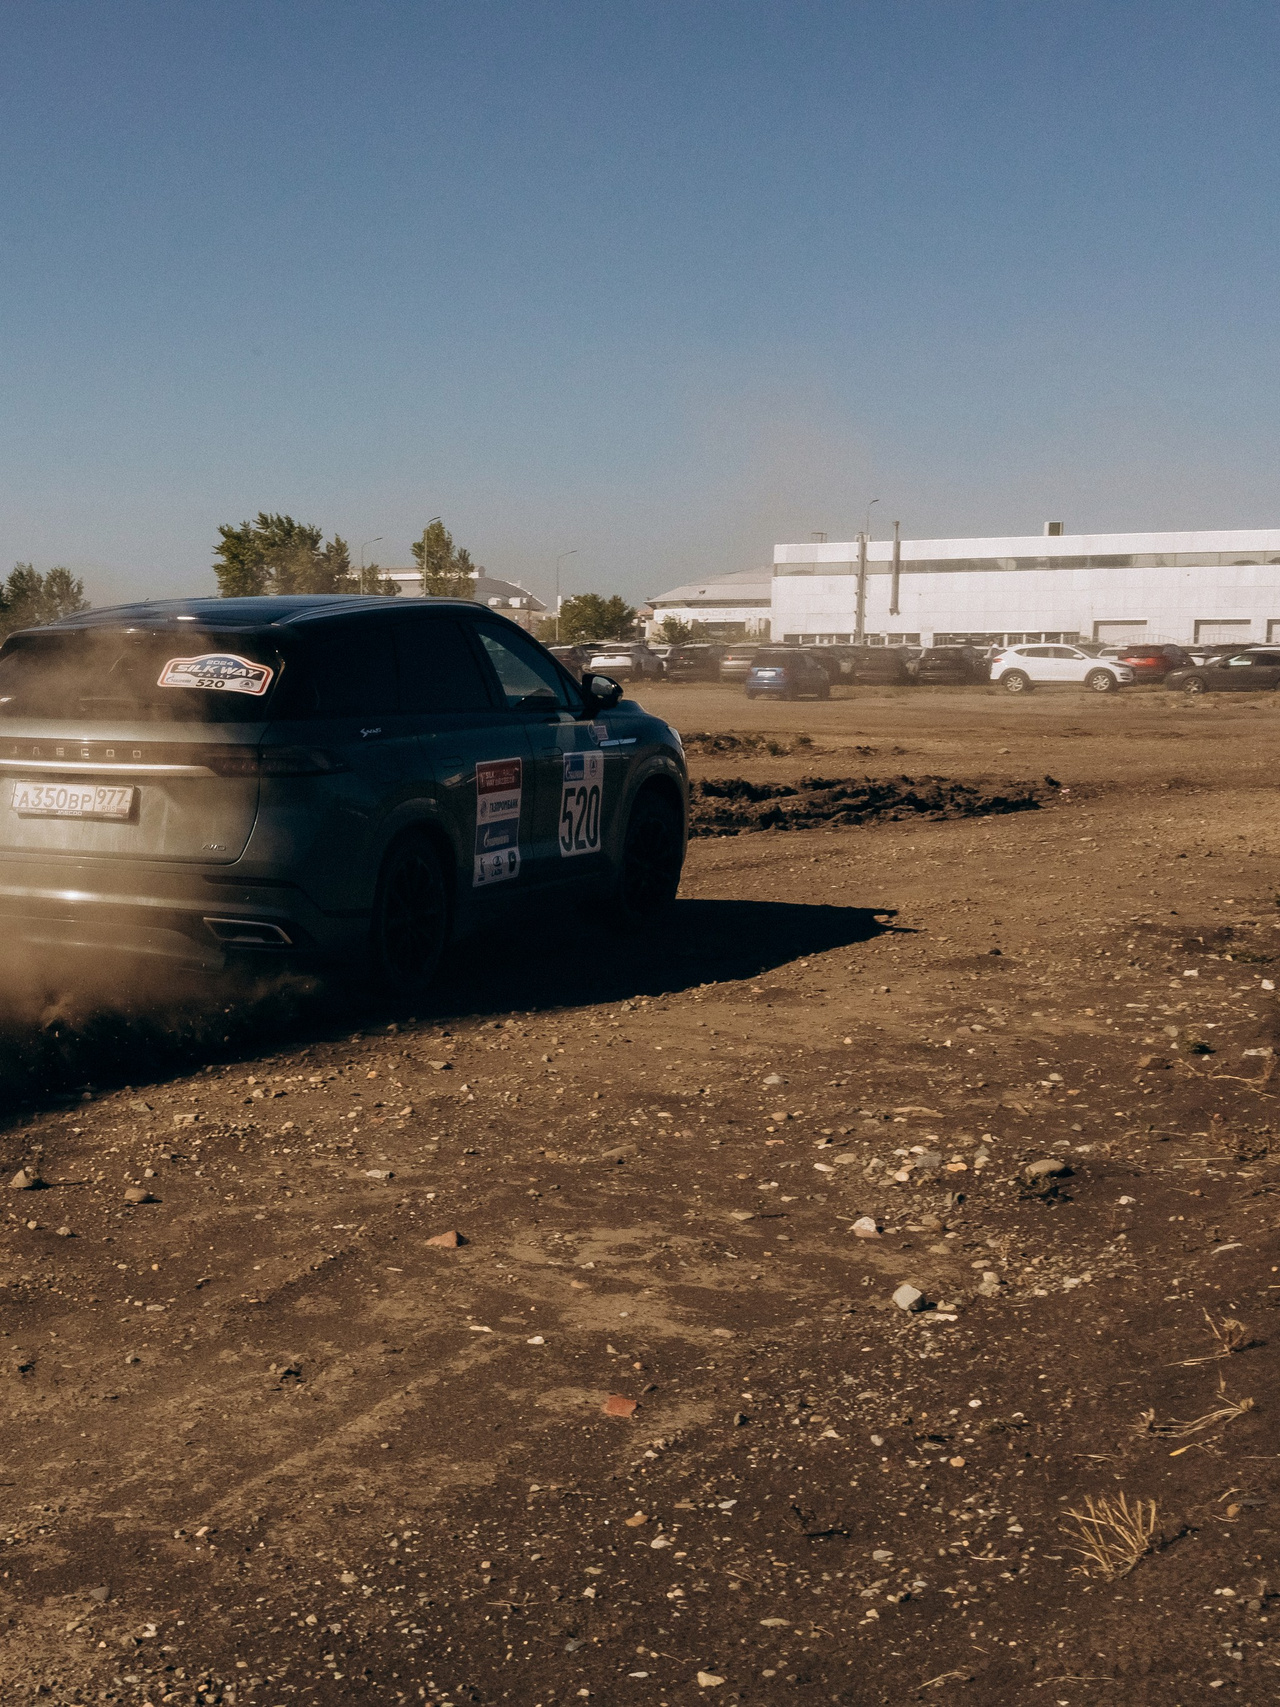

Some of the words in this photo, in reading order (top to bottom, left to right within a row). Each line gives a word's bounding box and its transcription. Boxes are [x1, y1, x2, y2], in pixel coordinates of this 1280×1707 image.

[174, 664, 219, 673] SILK
[219, 666, 261, 678] WAY
[195, 679, 225, 688] 520
[97, 788, 127, 805] 977
[560, 784, 601, 852] 520
